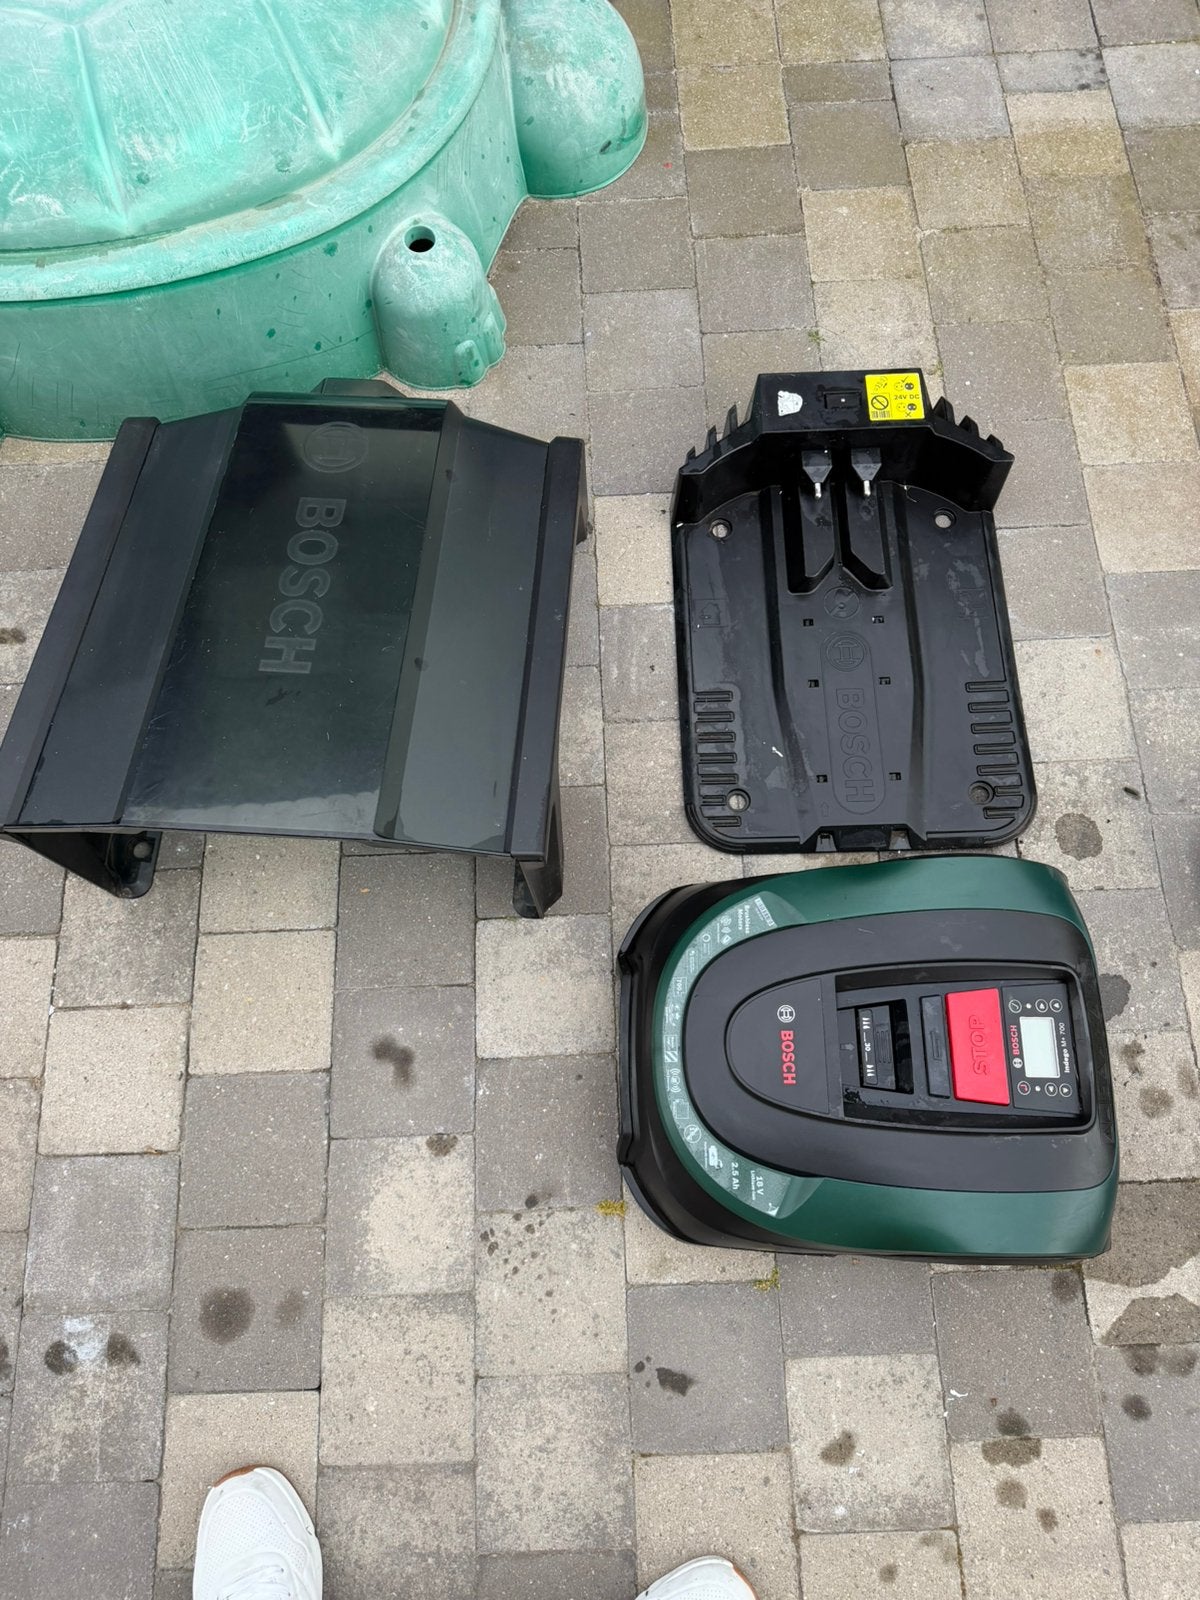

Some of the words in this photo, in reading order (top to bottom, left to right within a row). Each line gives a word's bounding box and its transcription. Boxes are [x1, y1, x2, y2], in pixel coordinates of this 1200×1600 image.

[258, 496, 347, 675] BOSCH
[836, 687, 876, 803] BOSCH
[968, 1014, 988, 1076] STOP
[1010, 1024, 1020, 1056] BOSCH
[1059, 1036, 1067, 1048] M+
[779, 1030, 797, 1085] BOSCH
[1062, 1048, 1071, 1073] Indego
[731, 1162, 739, 1176] 2.5
[756, 1175, 764, 1188] 18
[732, 1177, 740, 1190] Ah
[756, 1188, 764, 1196] V
